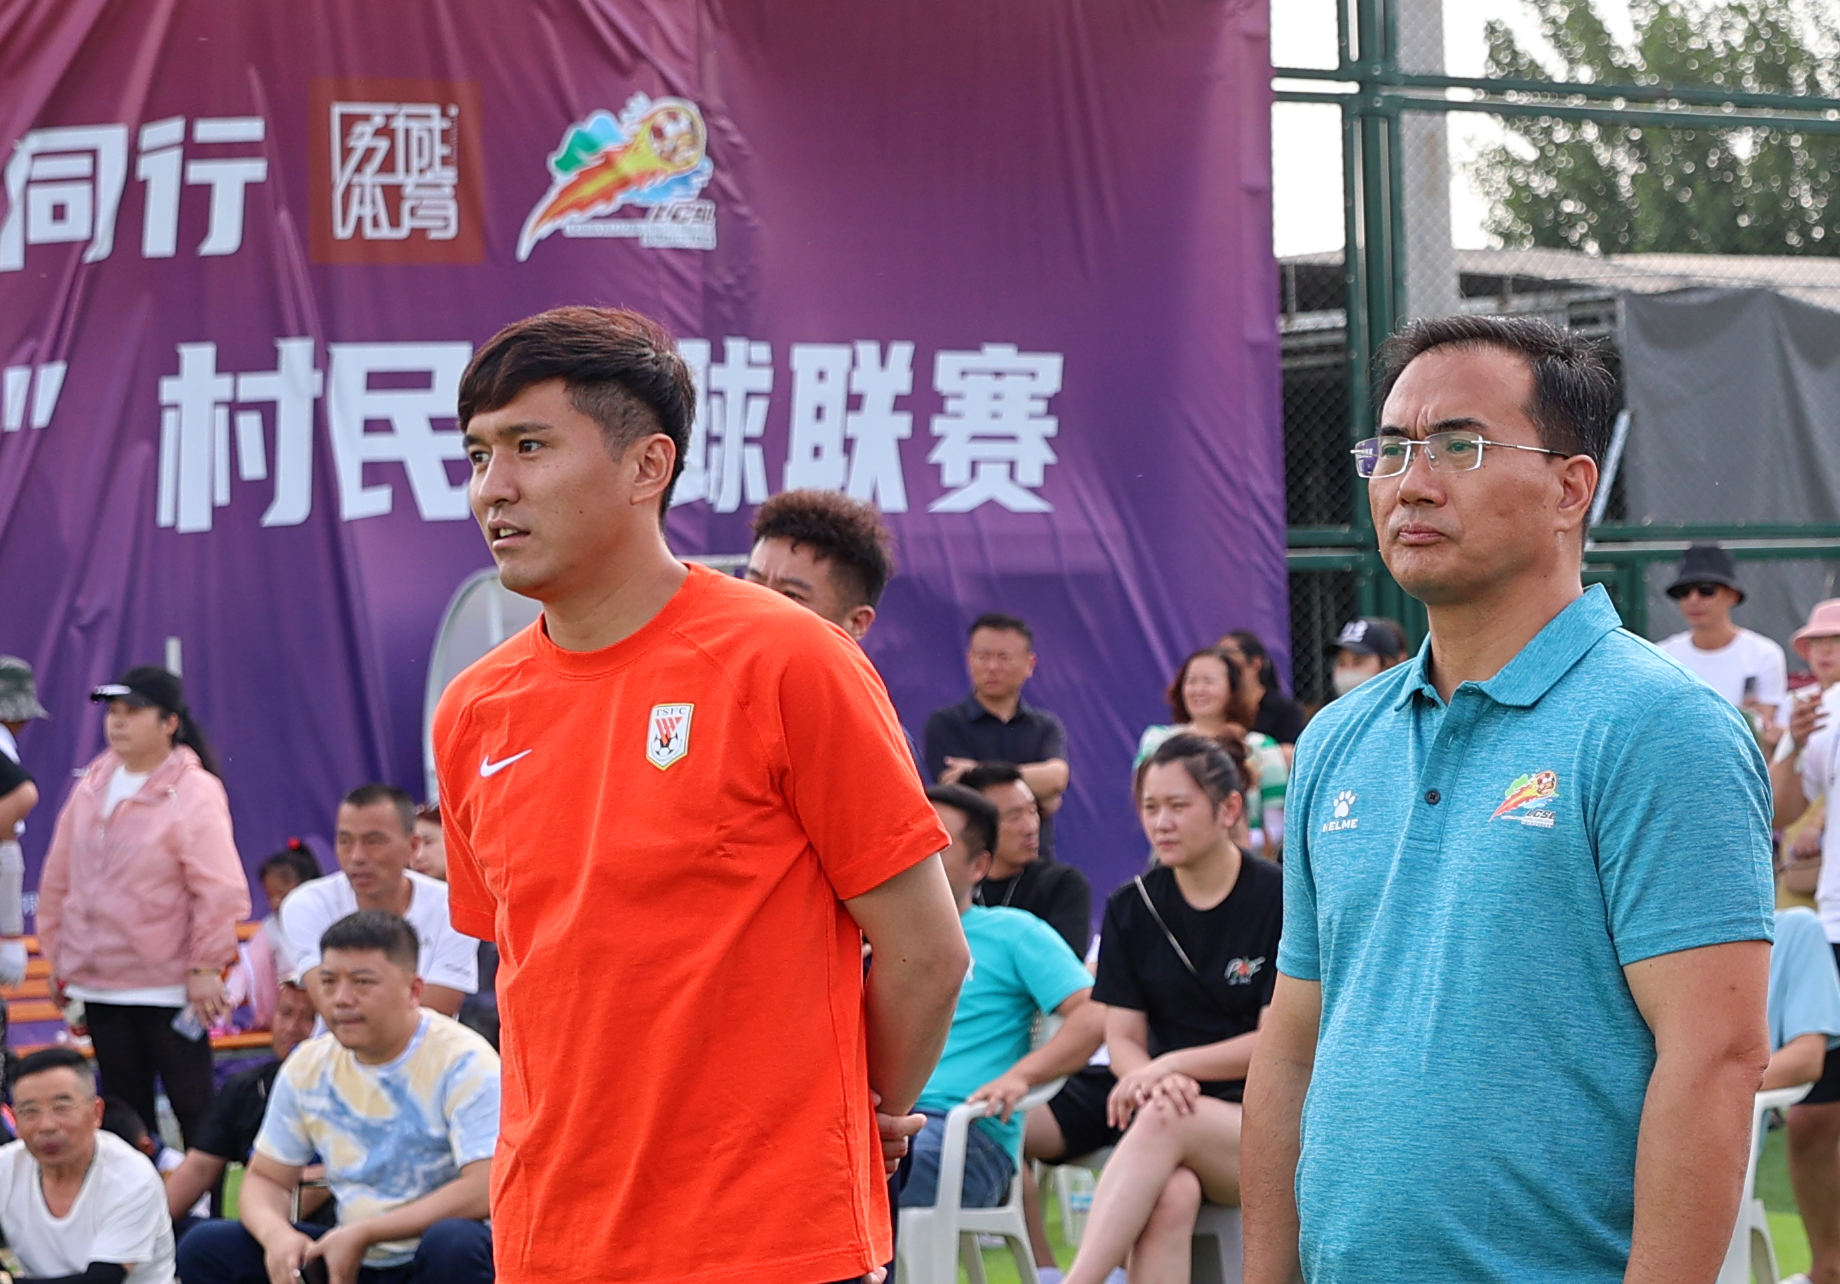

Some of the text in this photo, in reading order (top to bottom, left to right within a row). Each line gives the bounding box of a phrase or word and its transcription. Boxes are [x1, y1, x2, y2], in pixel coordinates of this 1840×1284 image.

[1, 115, 268, 272] 同行
[156, 335, 1064, 534] 村民球联赛
[655, 708, 687, 716] TSFC
